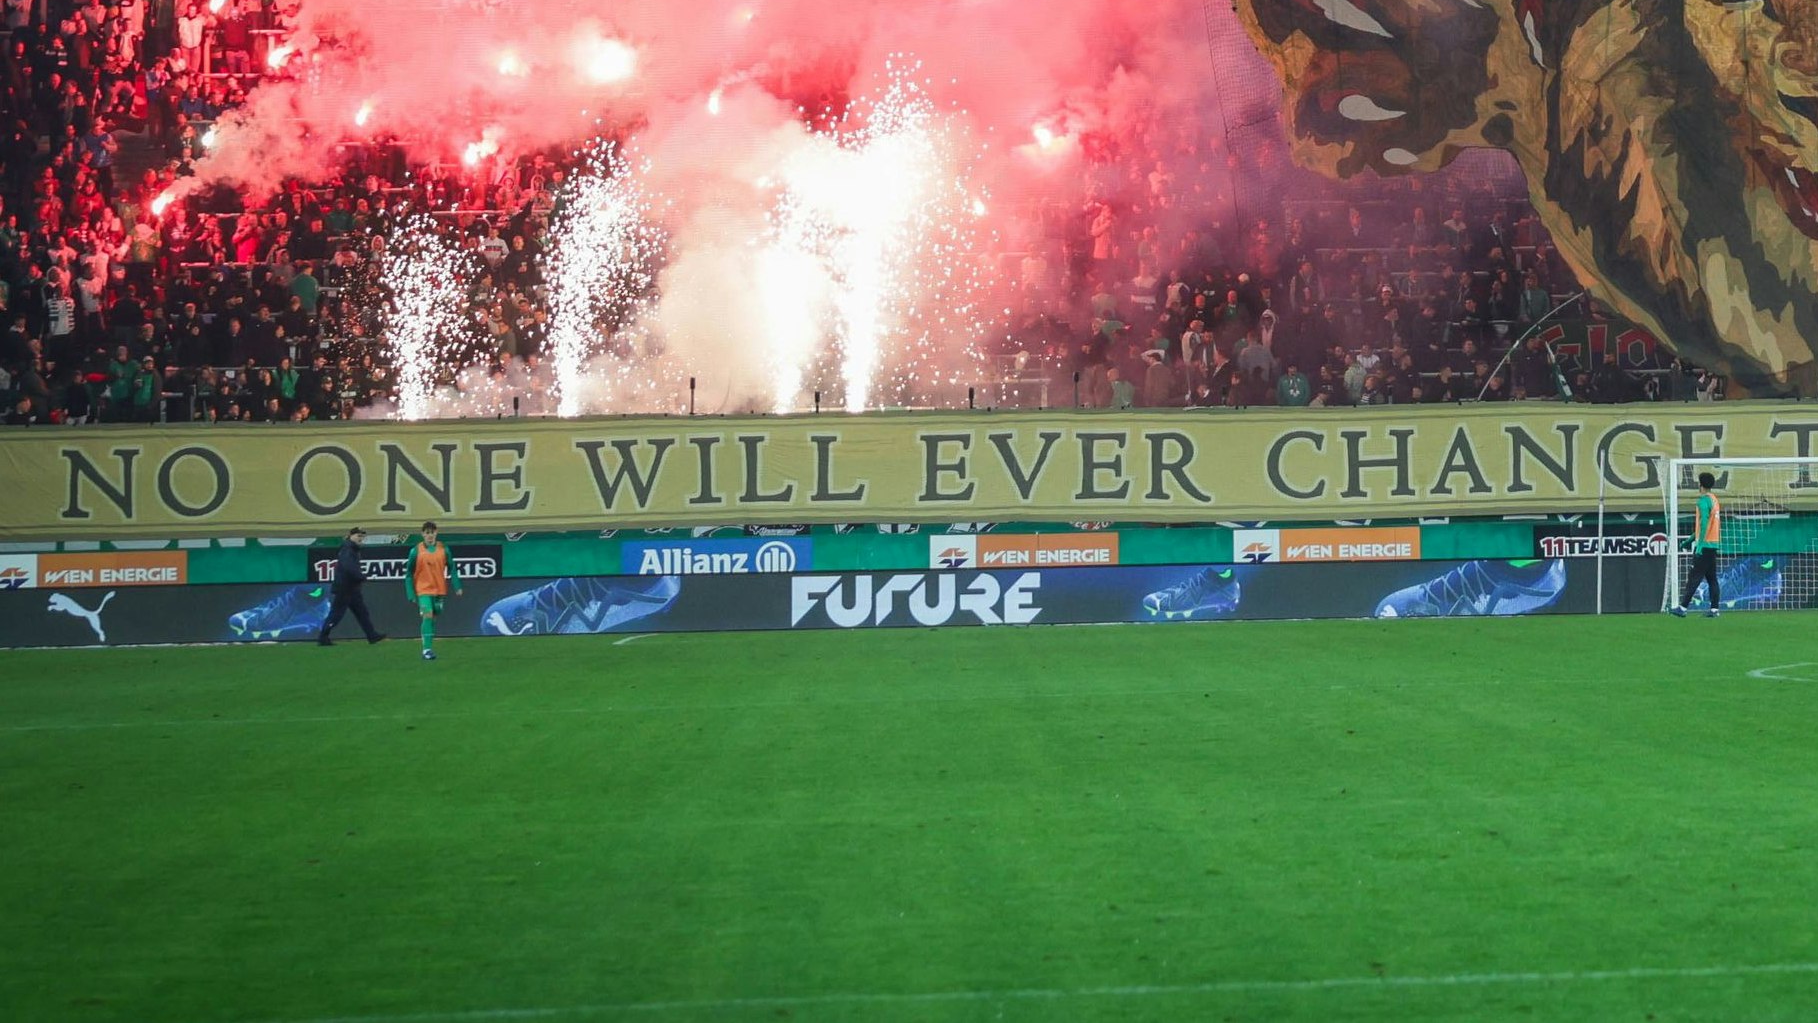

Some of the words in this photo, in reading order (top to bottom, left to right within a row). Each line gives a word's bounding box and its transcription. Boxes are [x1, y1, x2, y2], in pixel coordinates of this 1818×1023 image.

[61, 446, 231, 519] NO
[290, 441, 532, 516] ONE
[575, 434, 867, 510] WILL
[918, 432, 1211, 504] EVER
[1266, 422, 1728, 498] CHANGE
[983, 550, 1030, 564] WIEN
[1035, 549, 1110, 563] ENERGIE
[1286, 544, 1333, 559] WIEN
[1338, 543, 1412, 558] ENERGIE
[1540, 533, 1695, 557] 11TEAMSPO
[639, 548, 749, 575] Allianz
[44, 569, 94, 584] WIEN
[100, 567, 178, 583] ENERGIE
[791, 572, 1043, 628] FUTURE
